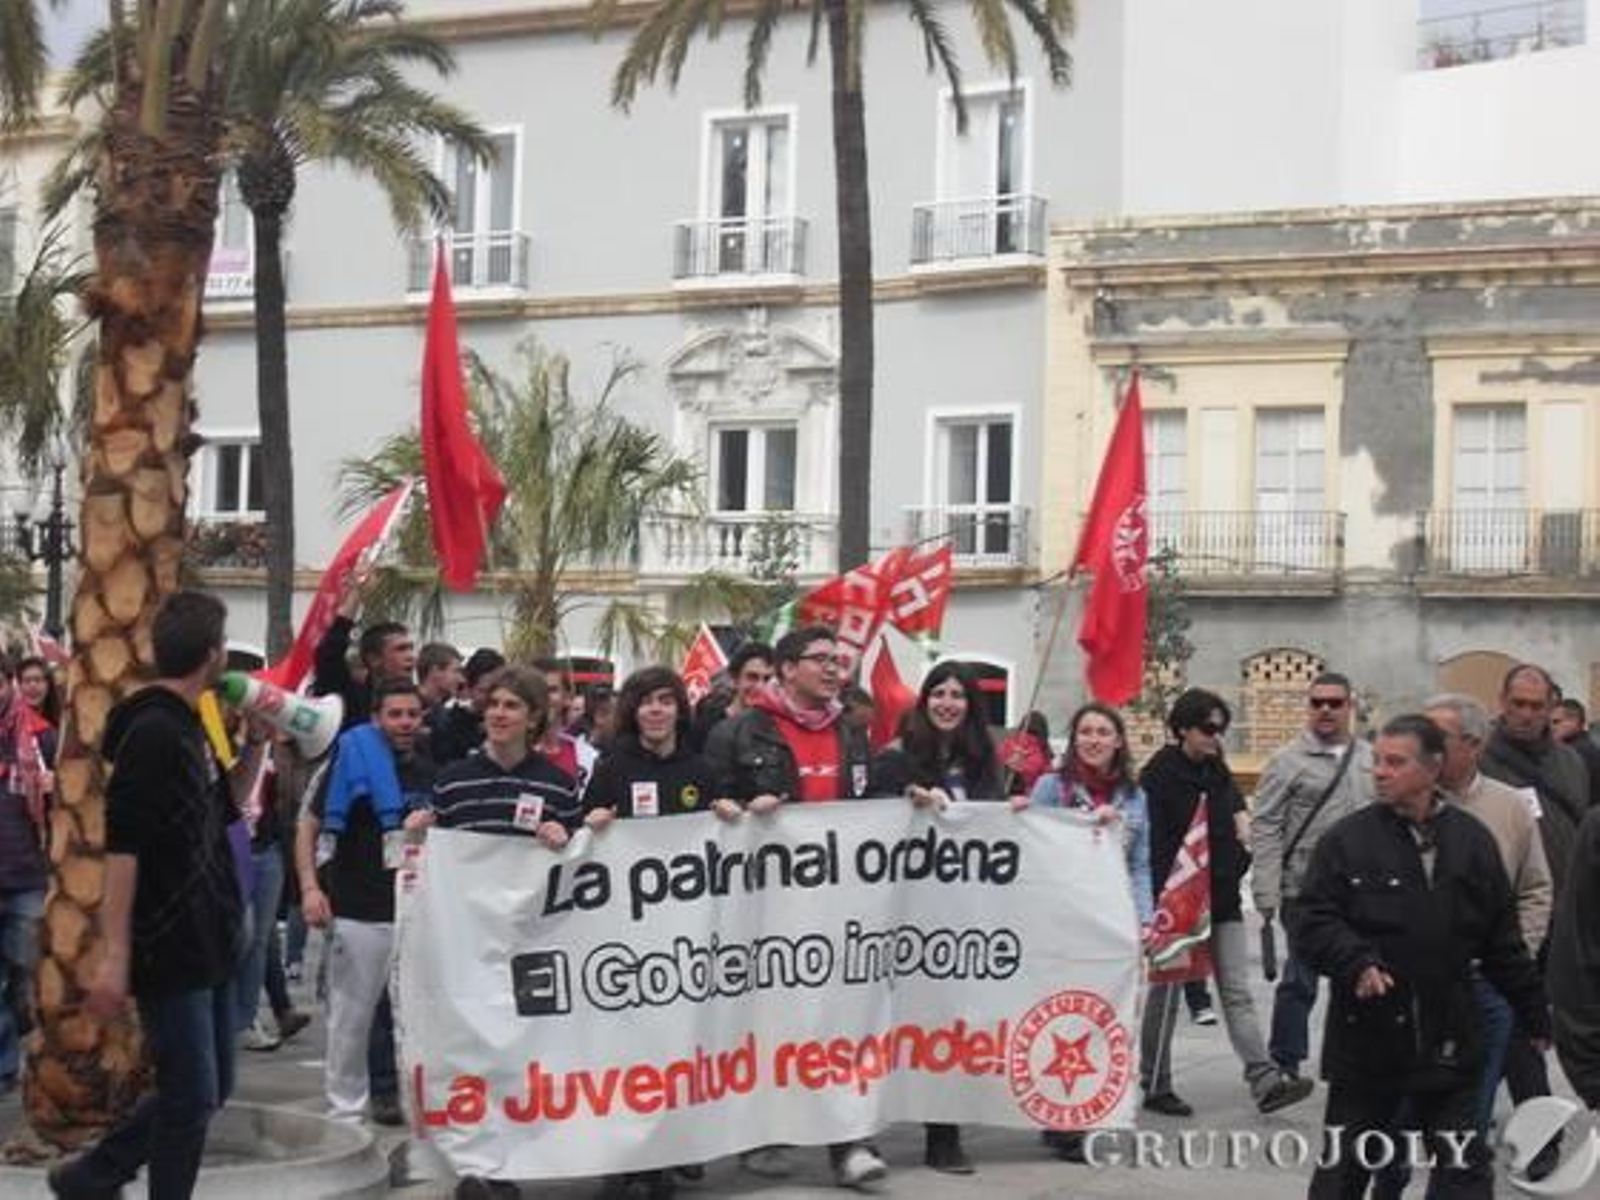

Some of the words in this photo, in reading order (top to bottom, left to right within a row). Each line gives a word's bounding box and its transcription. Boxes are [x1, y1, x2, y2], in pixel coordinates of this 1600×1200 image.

[542, 861, 611, 916] La
[630, 829, 838, 920] patrnal
[855, 827, 1020, 885] ordena
[511, 949, 571, 1016] El
[582, 931, 834, 1011] Gobeno
[414, 1063, 487, 1139] La
[503, 1031, 757, 1122] Juventud
[775, 1019, 1008, 1096] respnde!
